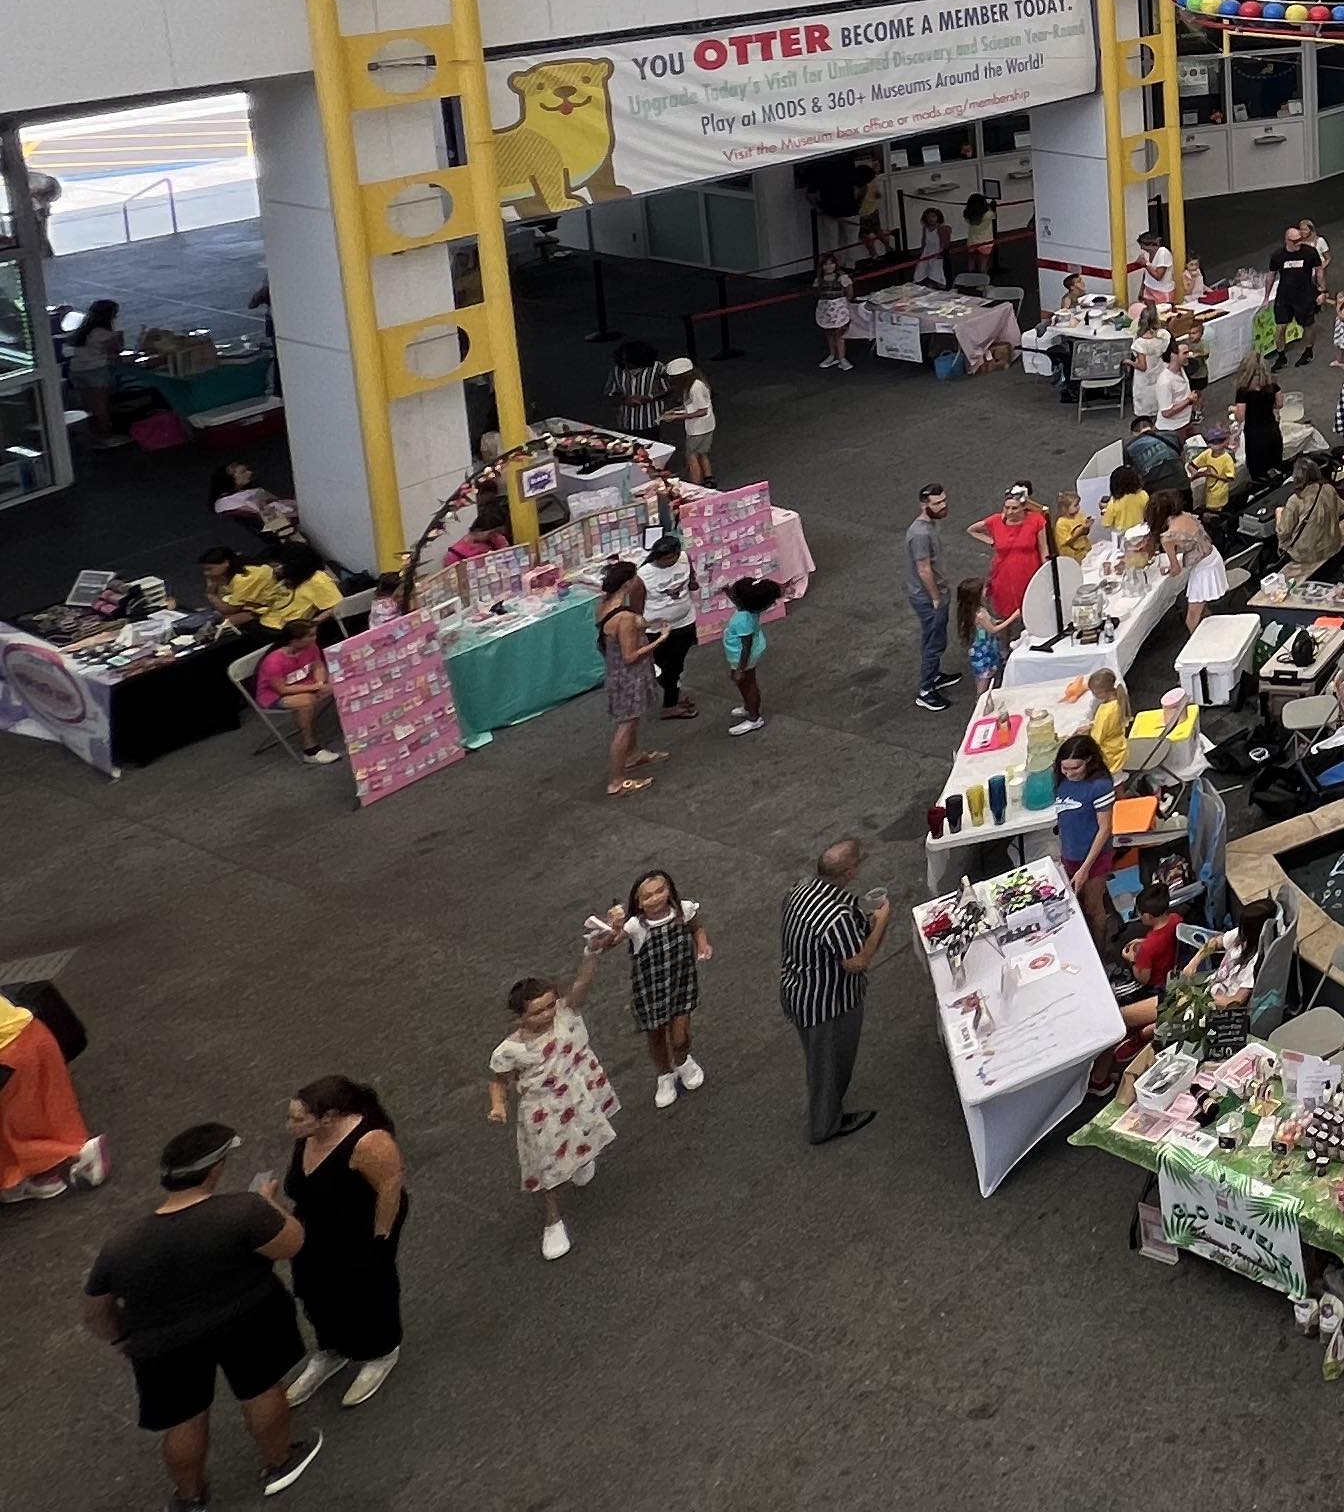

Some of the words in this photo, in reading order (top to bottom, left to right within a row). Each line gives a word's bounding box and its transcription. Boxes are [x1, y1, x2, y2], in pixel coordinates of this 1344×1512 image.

[632, 52, 685, 80] YOU
[694, 24, 832, 70] OTTER
[841, 15, 915, 48] BECOME
[921, 15, 933, 35] A
[939, 3, 1009, 30] MEMBER
[628, 90, 698, 116] Upgrade
[702, 78, 761, 102] Today's
[765, 71, 797, 90] Visit
[803, 68, 823, 85] for
[892, 46, 951, 69] Discovery
[701, 113, 735, 135] Play
[742, 110, 756, 127] at
[761, 98, 806, 123] MODS
[811, 97, 822, 113] &
[827, 88, 866, 110] 360+
[871, 77, 932, 102] Museums
[935, 64, 979, 89] Around
[984, 61, 1002, 78] the
[1005, 53, 1045, 75] World!
[723, 146, 752, 162] Visit
[756, 141, 777, 155] the
[781, 131, 833, 151] Museum
[837, 126, 859, 140] box
[863, 117, 893, 134] office
[898, 116, 908, 126] or
